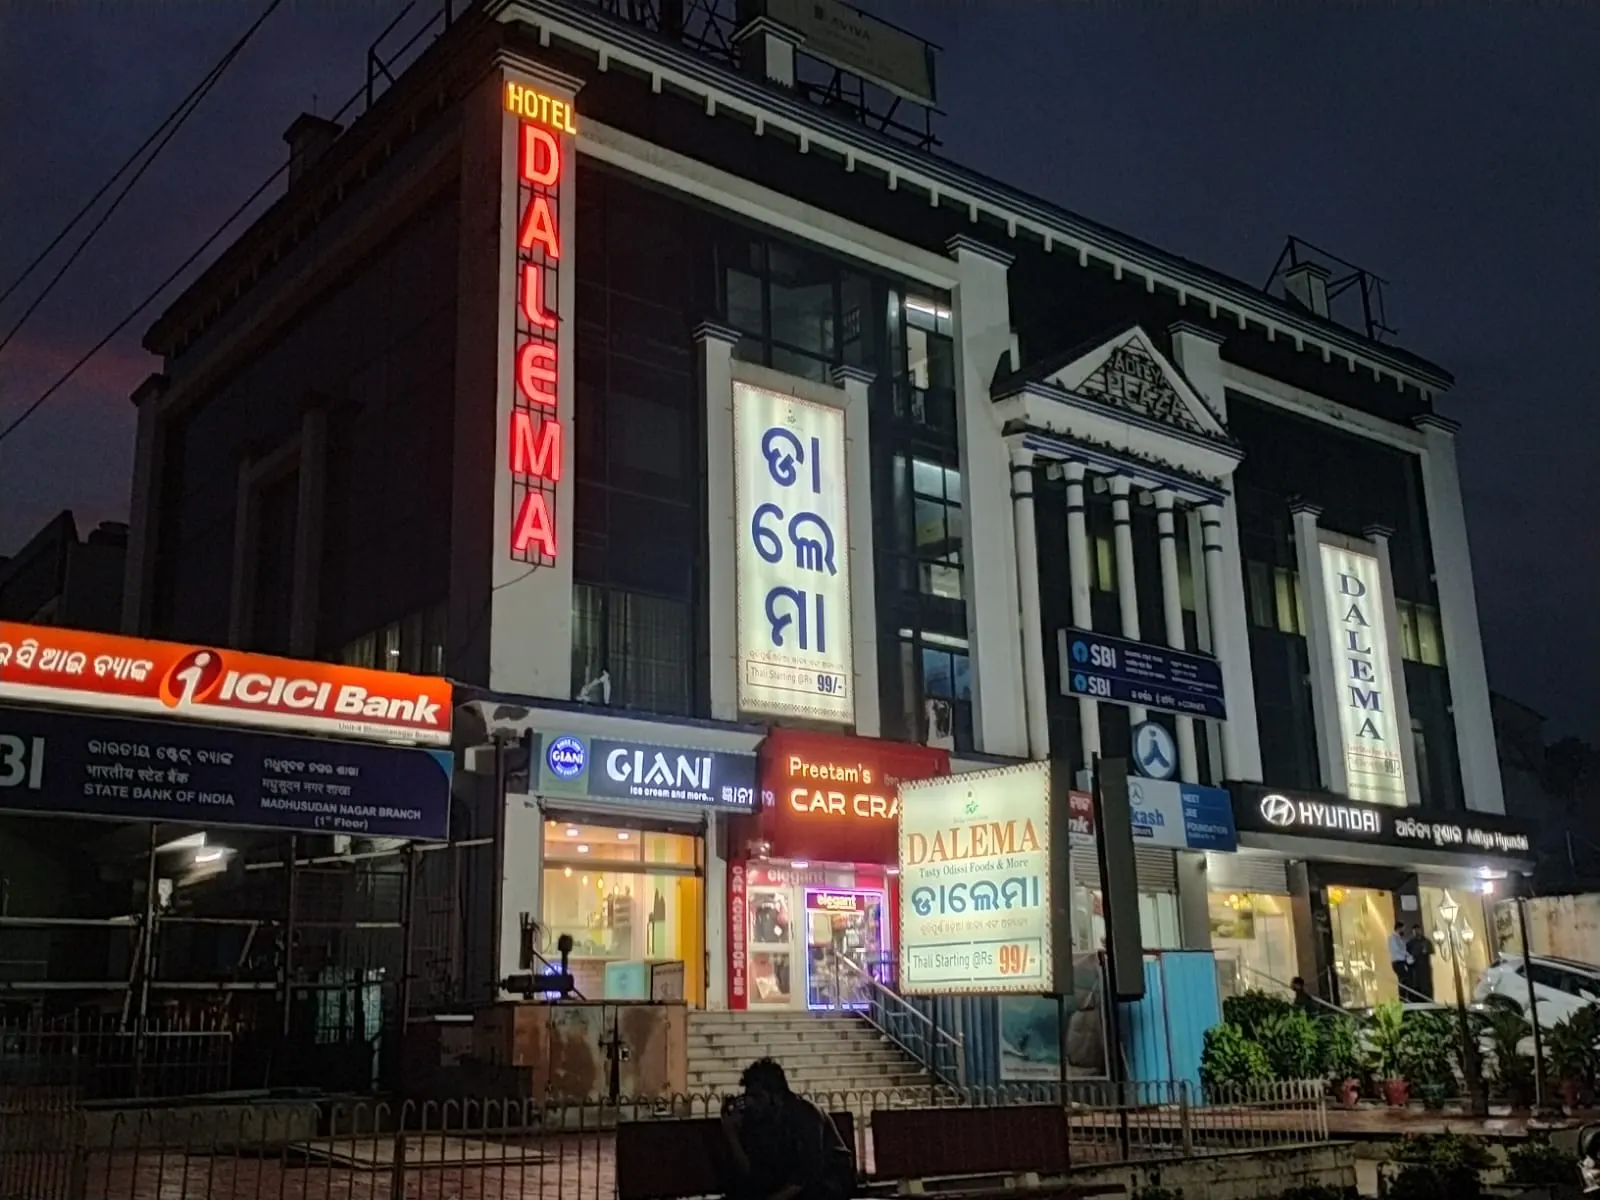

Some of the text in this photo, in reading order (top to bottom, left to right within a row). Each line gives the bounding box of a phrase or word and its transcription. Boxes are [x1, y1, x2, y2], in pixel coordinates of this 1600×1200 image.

[507, 81, 577, 135] HOTEL
[509, 123, 562, 558] DALEMA
[1090, 643, 1116, 669] SBI
[1337, 572, 1384, 741] DALEMA
[769, 669, 796, 684] Starting
[817, 674, 842, 694] 99/-
[1088, 677, 1111, 697] SBI
[219, 671, 441, 724] ICICI Bank
[86, 763, 135, 781] भारतीय
[606, 748, 712, 789] GIANI
[789, 756, 872, 784] Preetam's
[84, 783, 235, 806] STATE BANK OF INDIA
[671, 787, 685, 799] and
[790, 788, 846, 815] CAR
[260, 797, 422, 820] MADHUSUDAN NAGAR BRANCH
[1299, 802, 1381, 833] HYUNDAI
[334, 817, 369, 831] Floor)
[907, 817, 1041, 866] DALEMA
[1496, 832, 1529, 851] Hyundai
[919, 858, 1029, 879] Tasty Odissi Foods & More
[913, 955, 933, 969] Thali
[936, 953, 970, 970] Starting
[972, 951, 993, 969] @Rs
